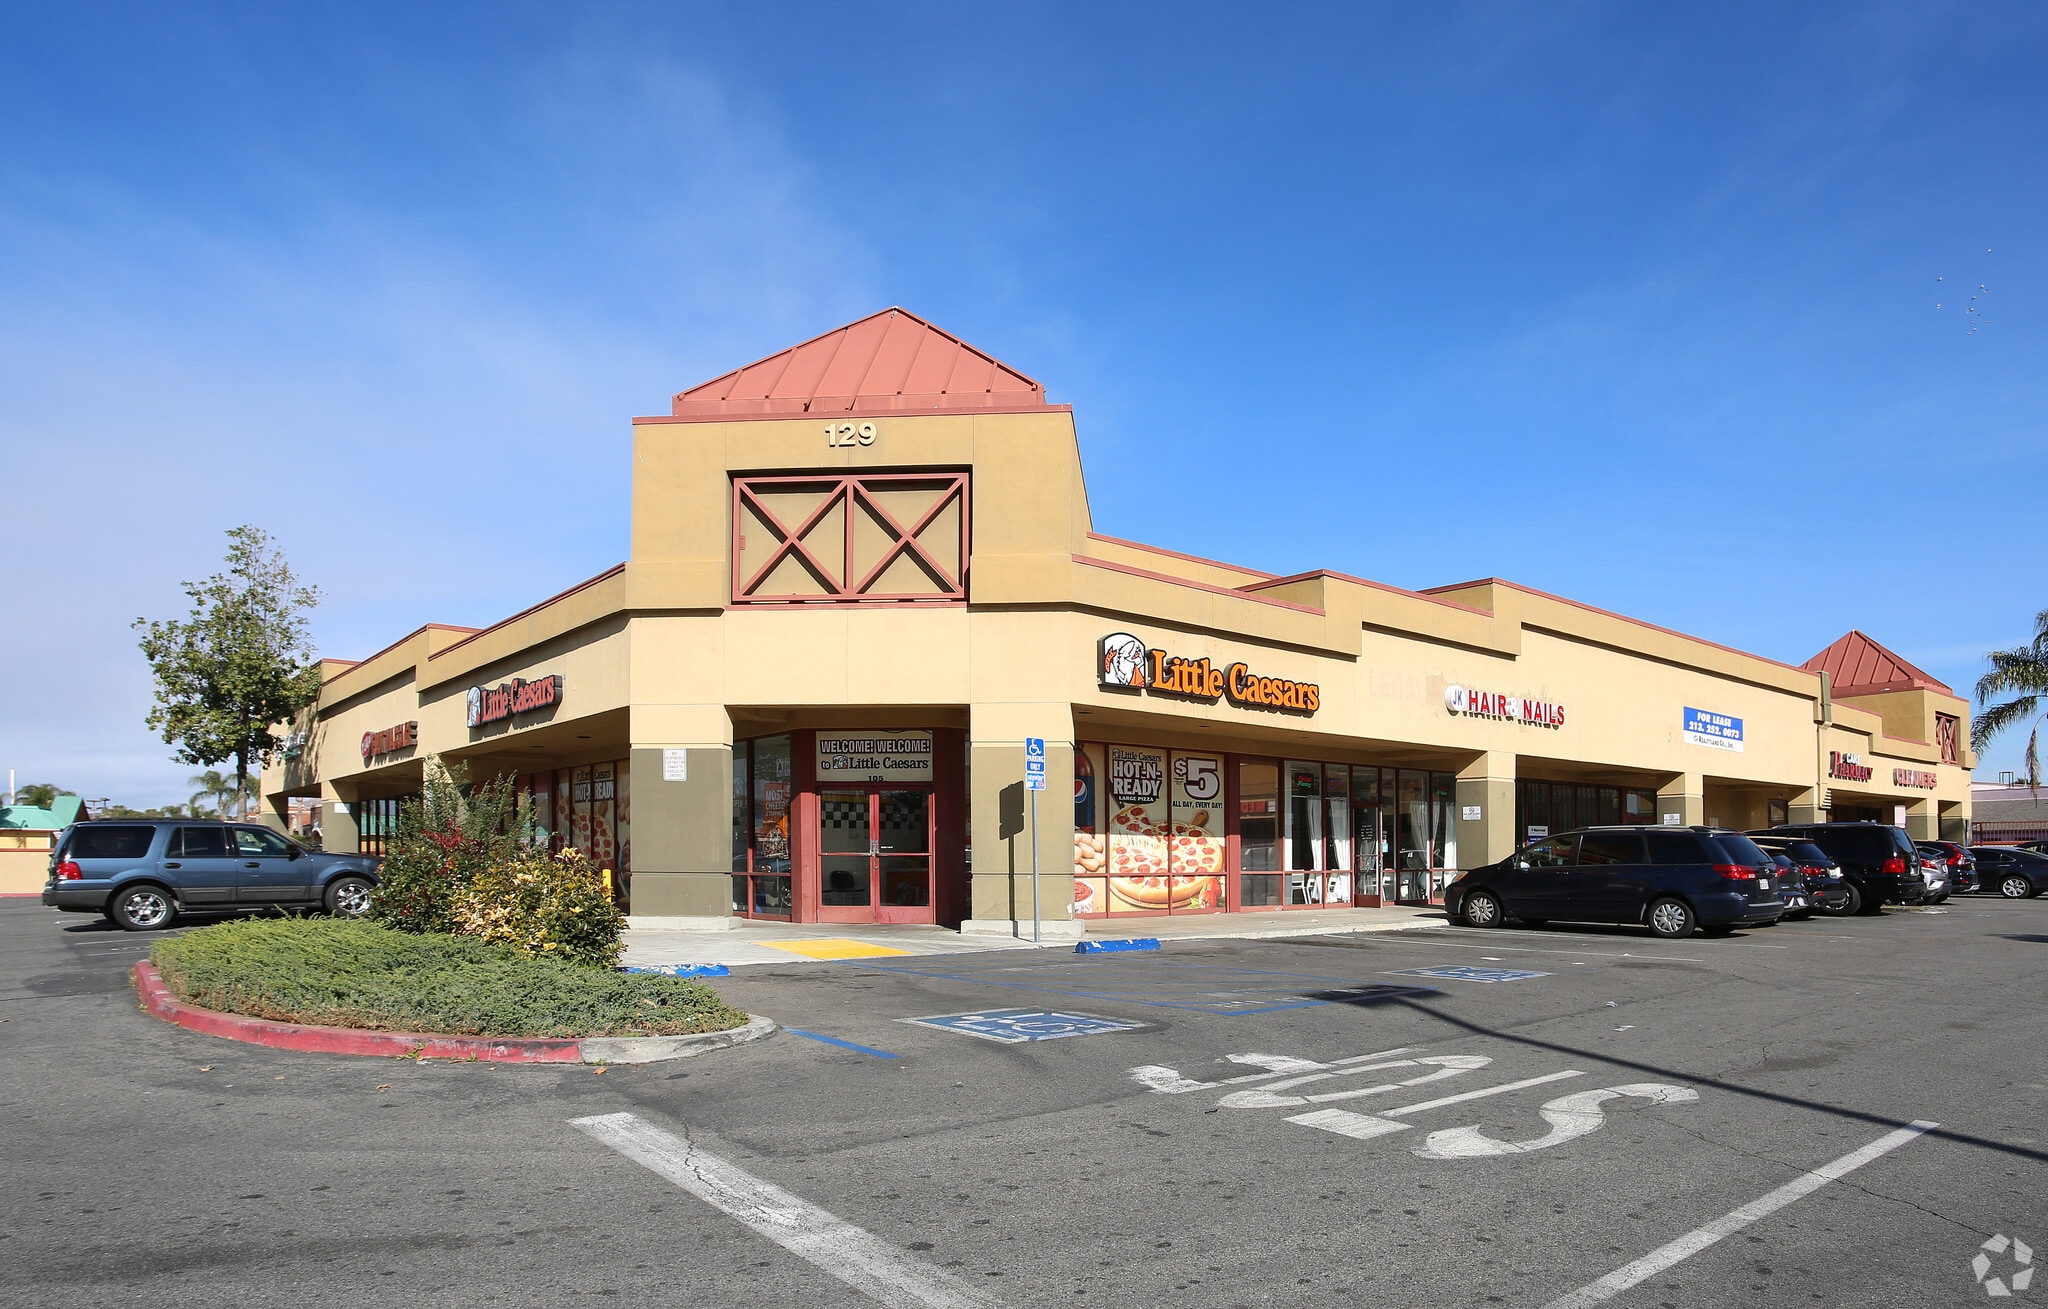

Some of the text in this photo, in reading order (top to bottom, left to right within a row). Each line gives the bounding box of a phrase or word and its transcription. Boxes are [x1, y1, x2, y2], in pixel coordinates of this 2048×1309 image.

[825, 422, 877, 448] 129
[1151, 649, 1224, 698] Little
[1227, 662, 1320, 712] Caesars
[481, 676, 555, 721] Little Caesars
[1452, 689, 1463, 707] JK
[1468, 689, 1507, 716] HAIR
[1507, 697, 1519, 717] &
[1523, 699, 1565, 726] NAILS
[1688, 720, 1705, 732] 213.
[1697, 712, 1732, 727] FOR LEASE
[820, 739, 931, 753] WELCOME! WELCOME!
[821, 757, 928, 769] to Little Caesars
[1121, 751, 1162, 762] Little Caesars
[1833, 751, 1873, 780] PHARMACY
[1846, 752, 1861, 765] CARE
[1113, 760, 1161, 779] HOT-N-
[1174, 757, 1220, 800] $5
[1896, 768, 1937, 788] CLEANERS
[594, 781, 614, 800] READY
[765, 790, 784, 801] MOST
[1113, 778, 1161, 797] READY
[1172, 800, 1182, 808] ALL
